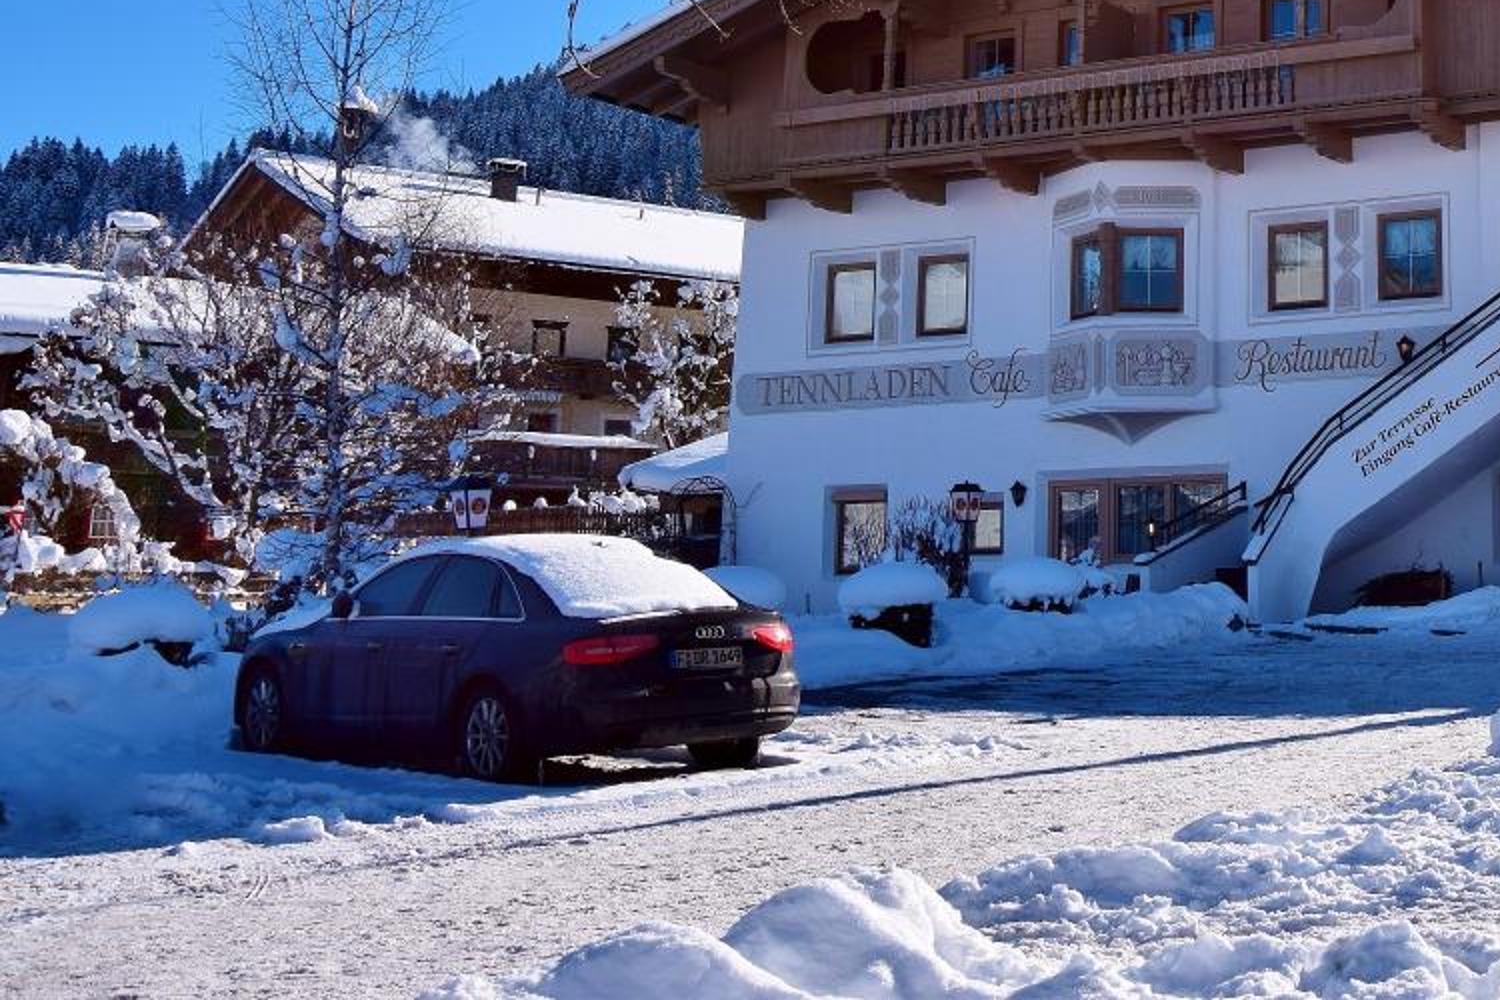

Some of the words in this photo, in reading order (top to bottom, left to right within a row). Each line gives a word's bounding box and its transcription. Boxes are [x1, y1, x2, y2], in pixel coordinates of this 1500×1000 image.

[755, 365, 953, 407] TENNLADEN
[1235, 330, 1387, 392] Restaurant
[1351, 439, 1377, 464] Zur
[1377, 397, 1435, 443] Terrasse
[1360, 433, 1415, 477] Eingang
